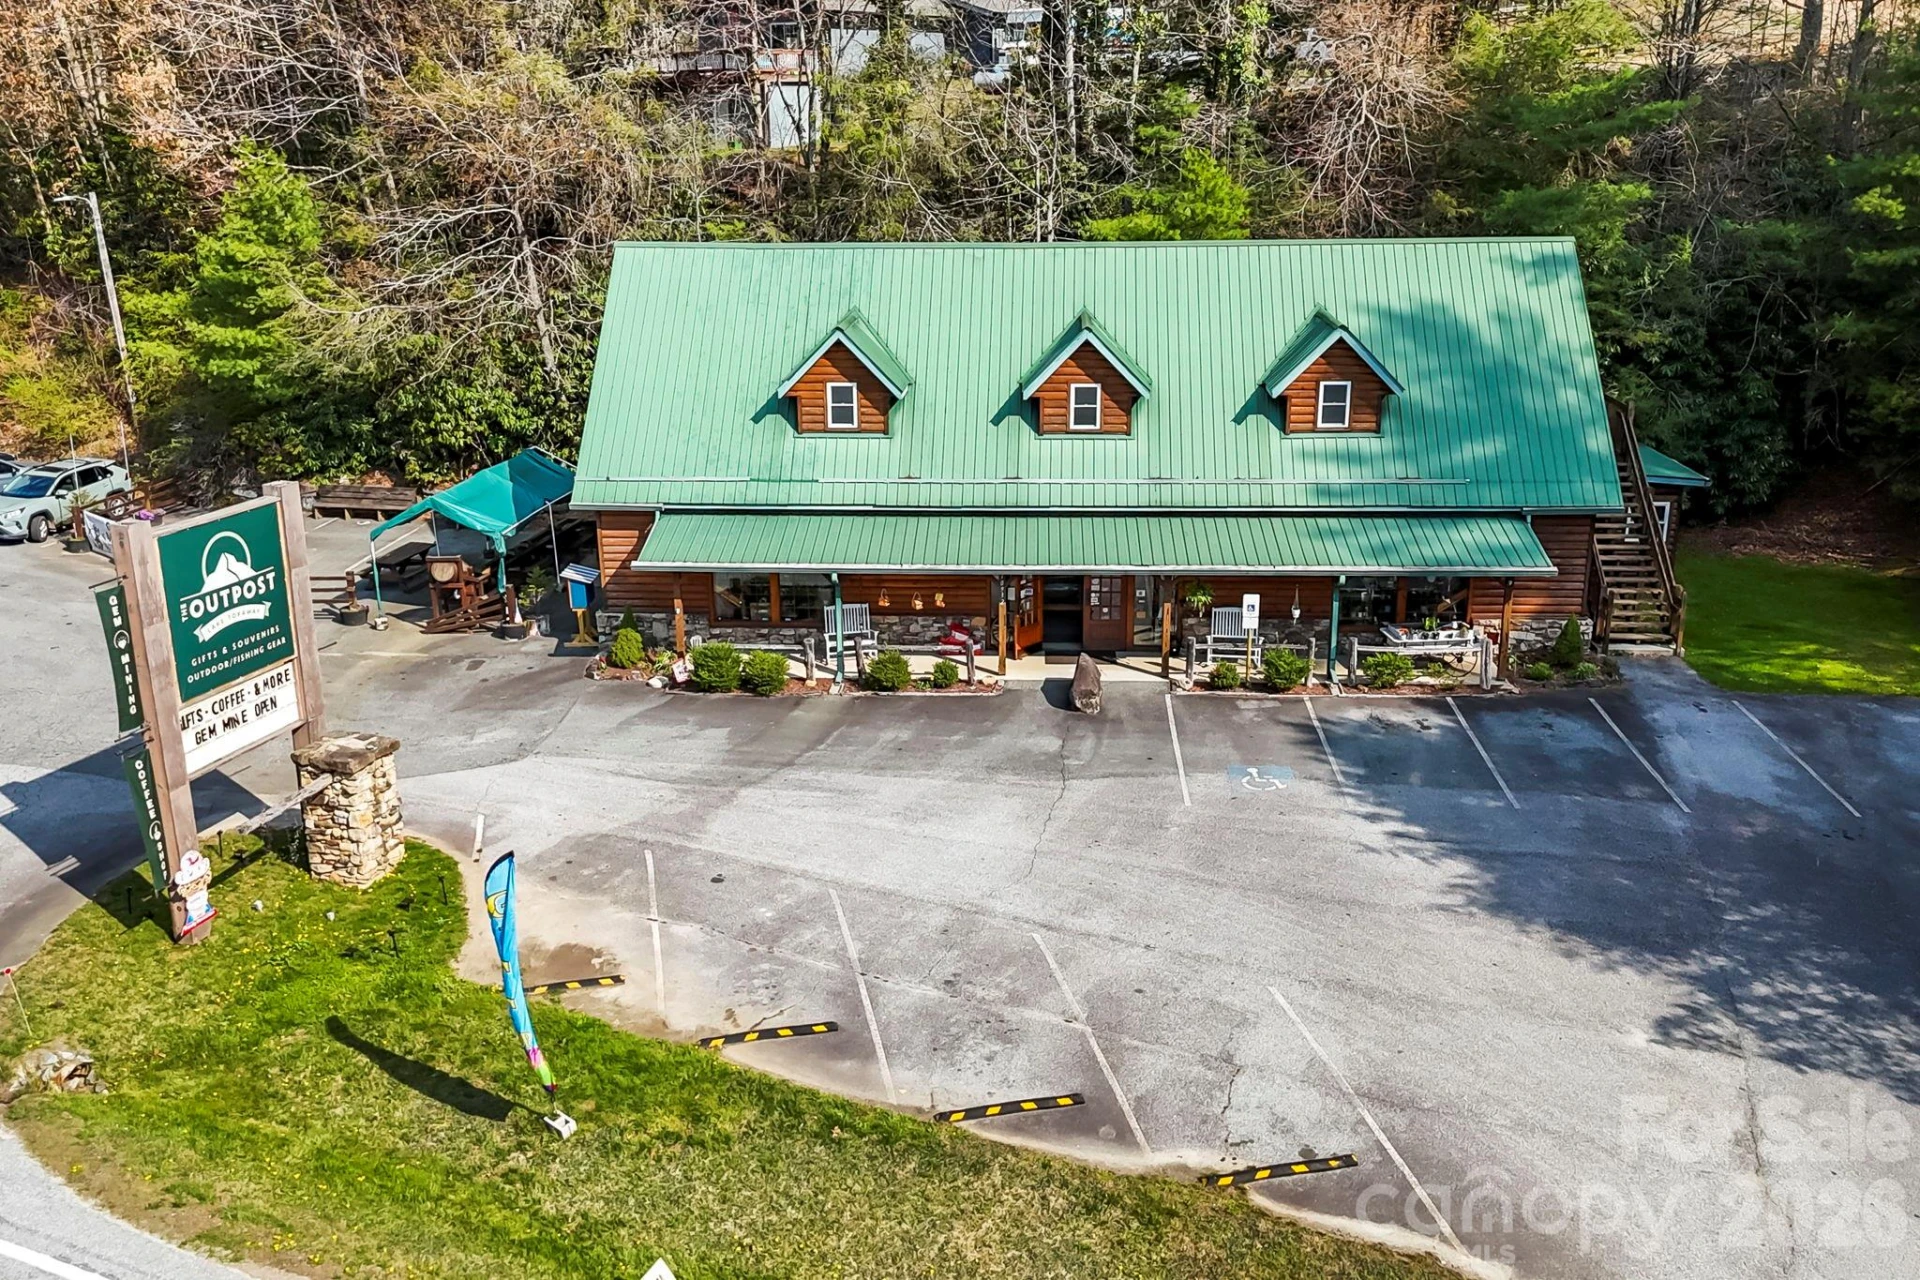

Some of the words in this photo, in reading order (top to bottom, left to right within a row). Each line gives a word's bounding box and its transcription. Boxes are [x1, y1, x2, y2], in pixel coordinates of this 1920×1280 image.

[108, 595, 122, 627] GEM
[180, 602, 189, 623] THE
[188, 571, 276, 618] OUTPOST
[187, 645, 265, 683] OUTDOOR/FISHING
[266, 636, 287, 650] GEAR
[191, 650, 218, 667] GIFTS
[222, 646, 228, 654] &
[232, 624, 280, 651] SOUVENIRS
[120, 653, 137, 715] MINING
[211, 688, 246, 715] COFFEE
[253, 682, 261, 696] &
[262, 668, 291, 692] MORE
[194, 723, 218, 746] GEM
[222, 709, 248, 733] MINE
[254, 695, 278, 717] OPEN
[134, 759, 157, 820] COFFEE
